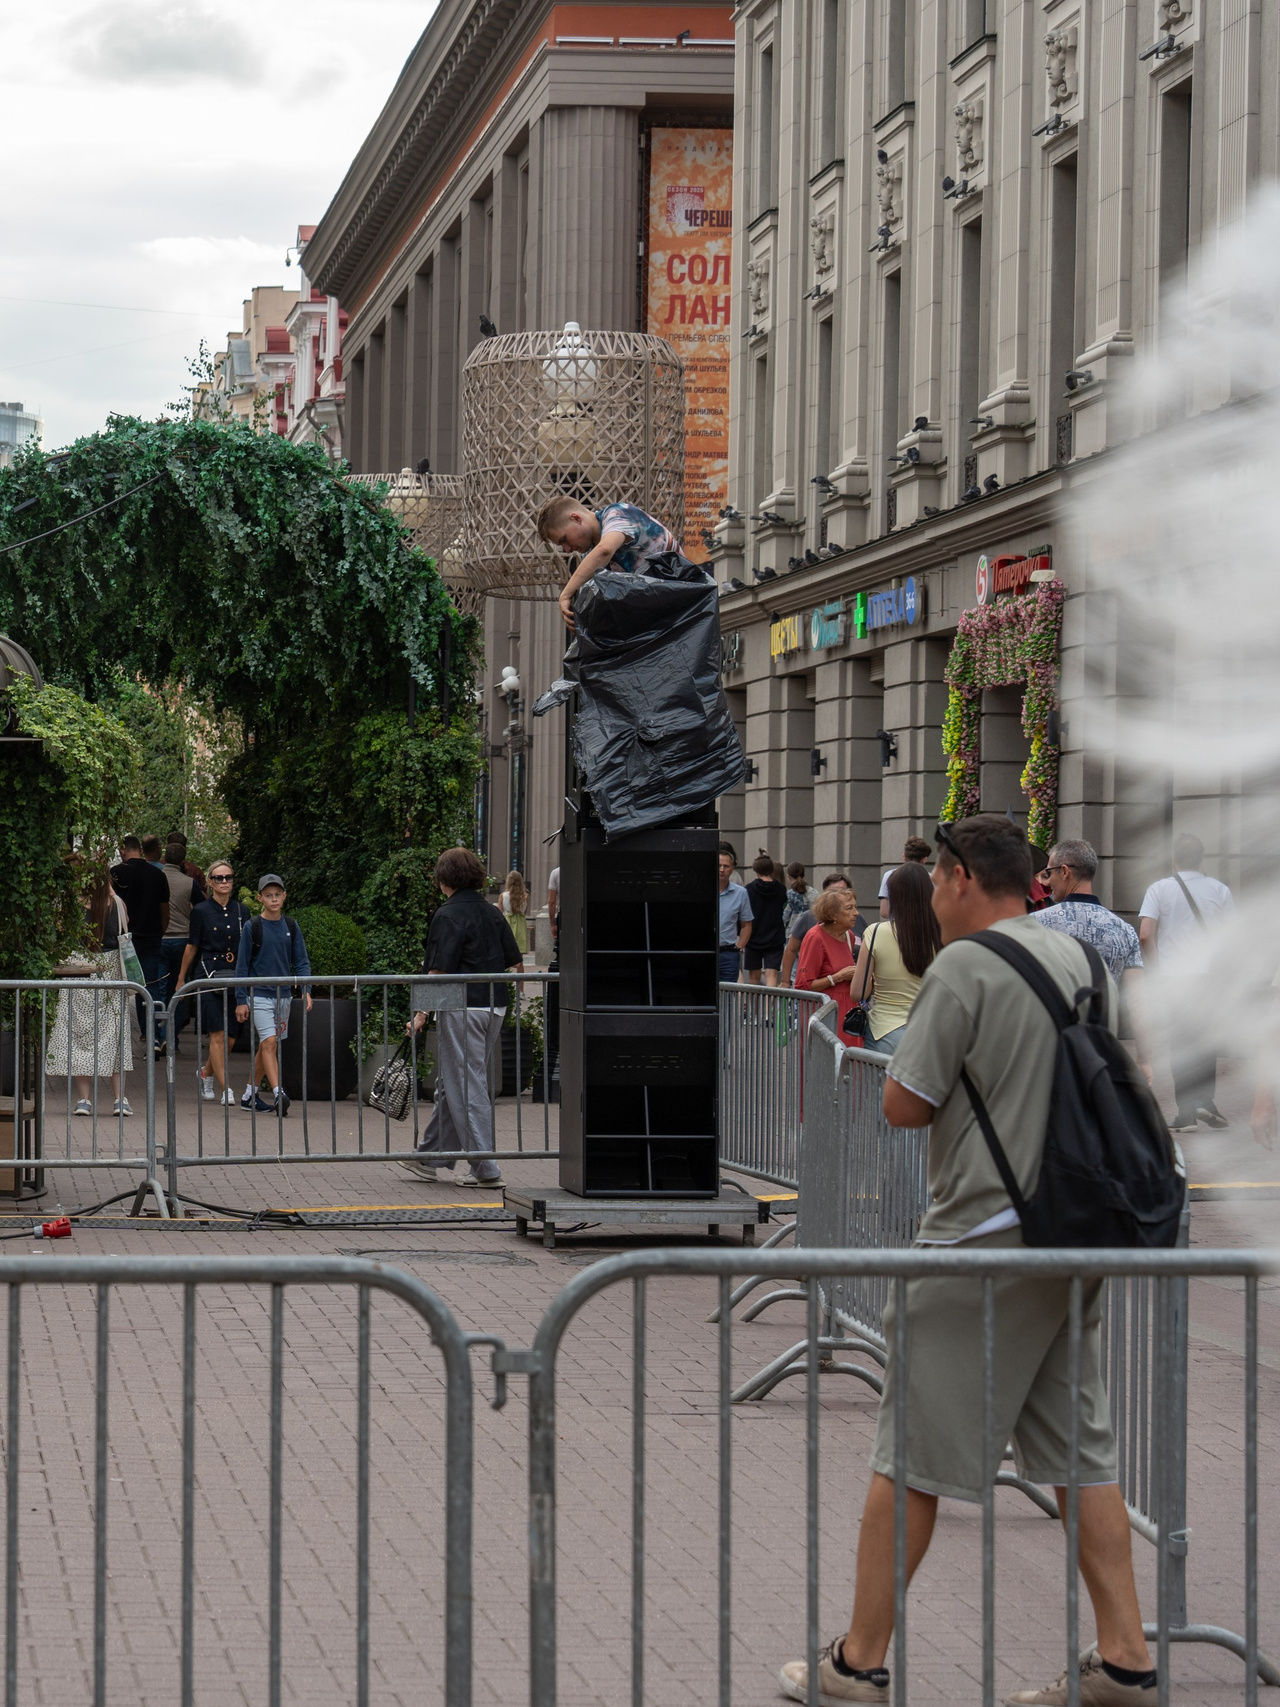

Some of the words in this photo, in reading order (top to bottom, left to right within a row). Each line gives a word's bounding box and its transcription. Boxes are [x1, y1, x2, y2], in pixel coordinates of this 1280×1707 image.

[666, 254, 731, 286] СОЛ
[664, 294, 731, 326] ЛАН
[699, 365, 727, 373] ШУЛЬЕВ
[685, 472, 708, 480] ПОПОВ
[866, 587, 905, 631] АПТЕКА
[771, 615, 798, 663] ЦВЕТЫ
